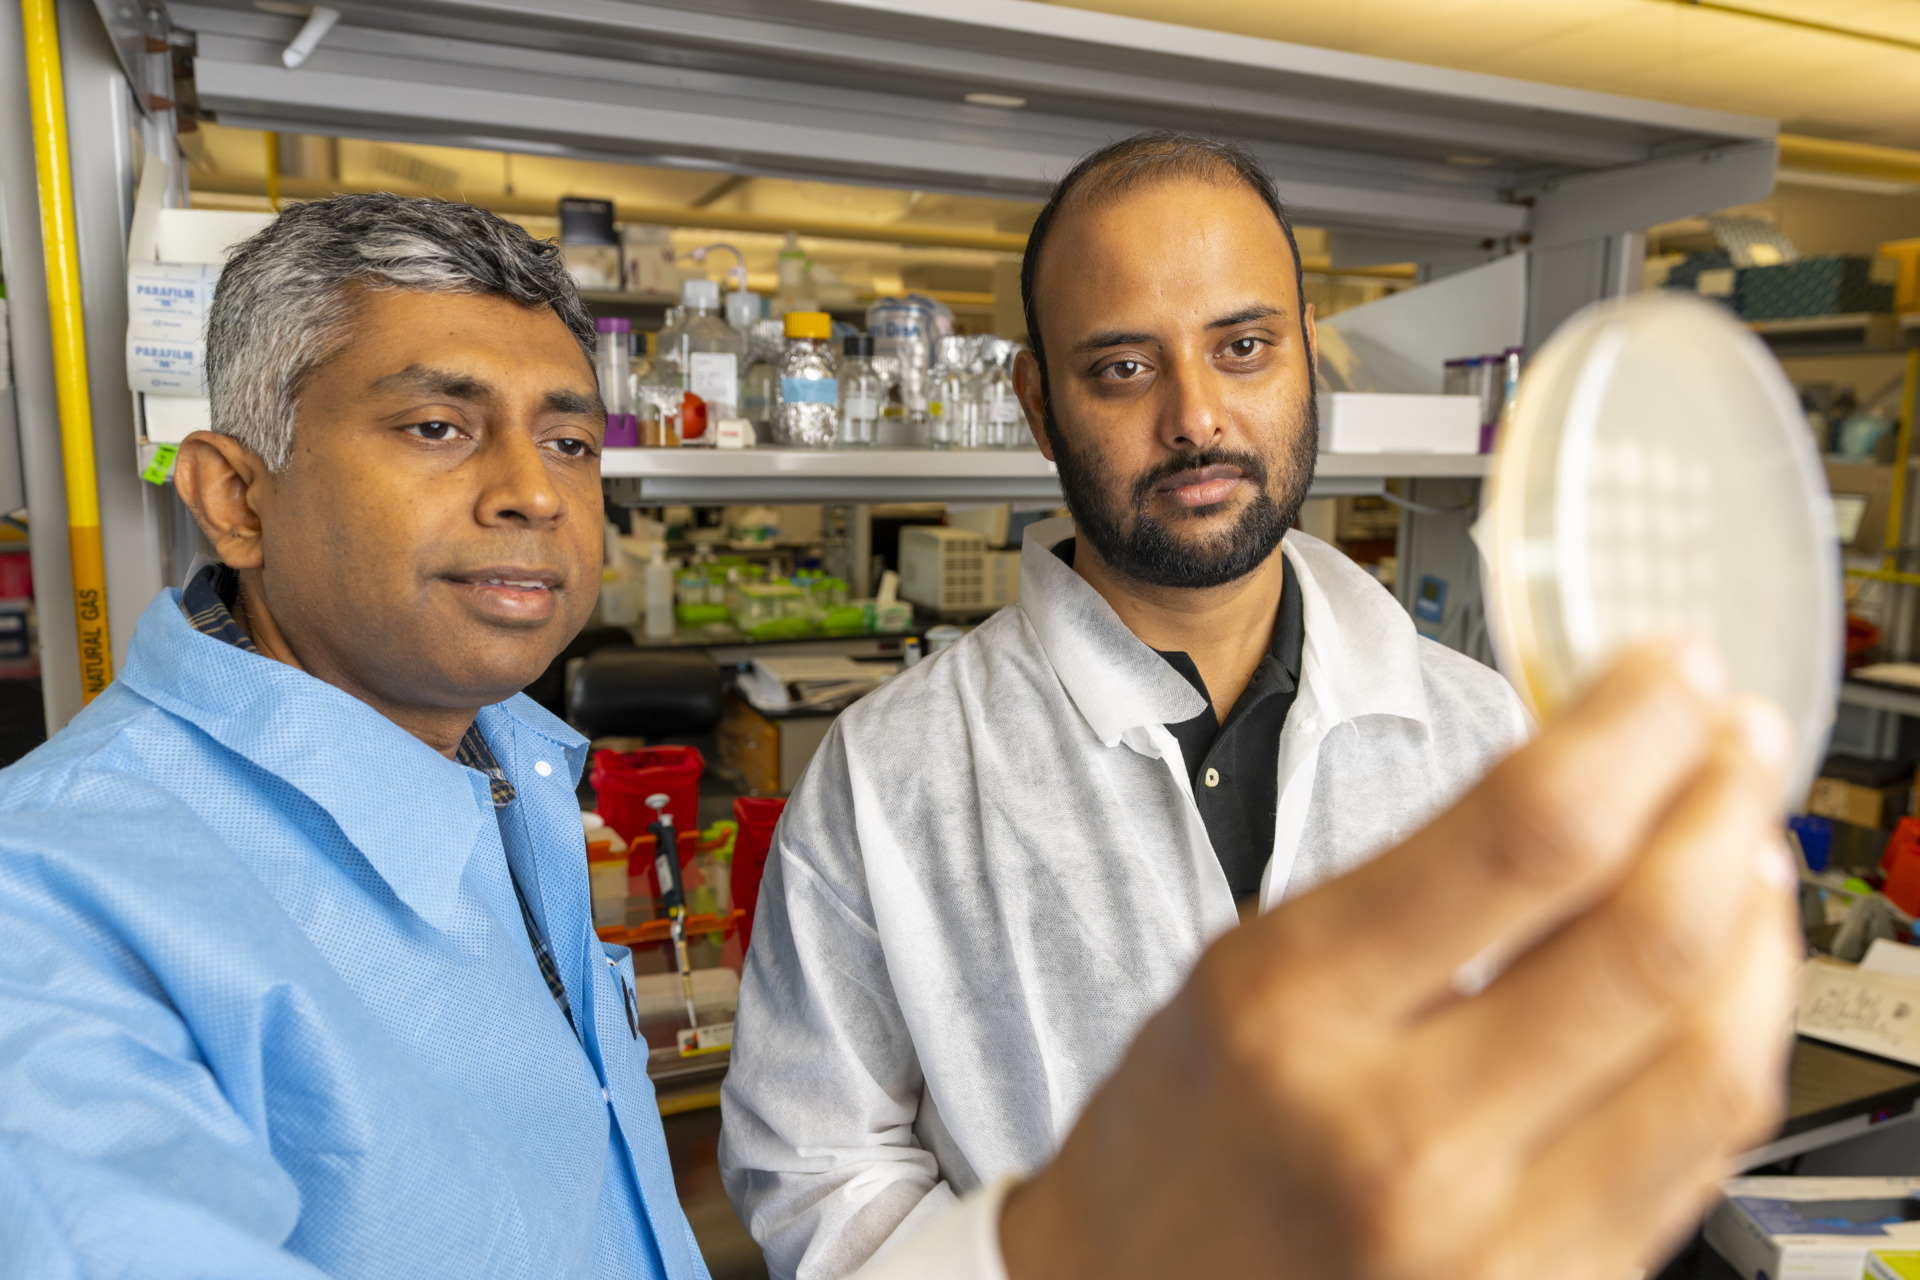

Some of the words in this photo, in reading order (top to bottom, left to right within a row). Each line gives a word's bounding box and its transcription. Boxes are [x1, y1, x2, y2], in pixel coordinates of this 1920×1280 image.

[137, 285, 194, 298] PARAFILM
[135, 346, 193, 359] PARAFILM
[79, 589, 99, 620] GAS
[83, 627, 105, 693] NATURAL
